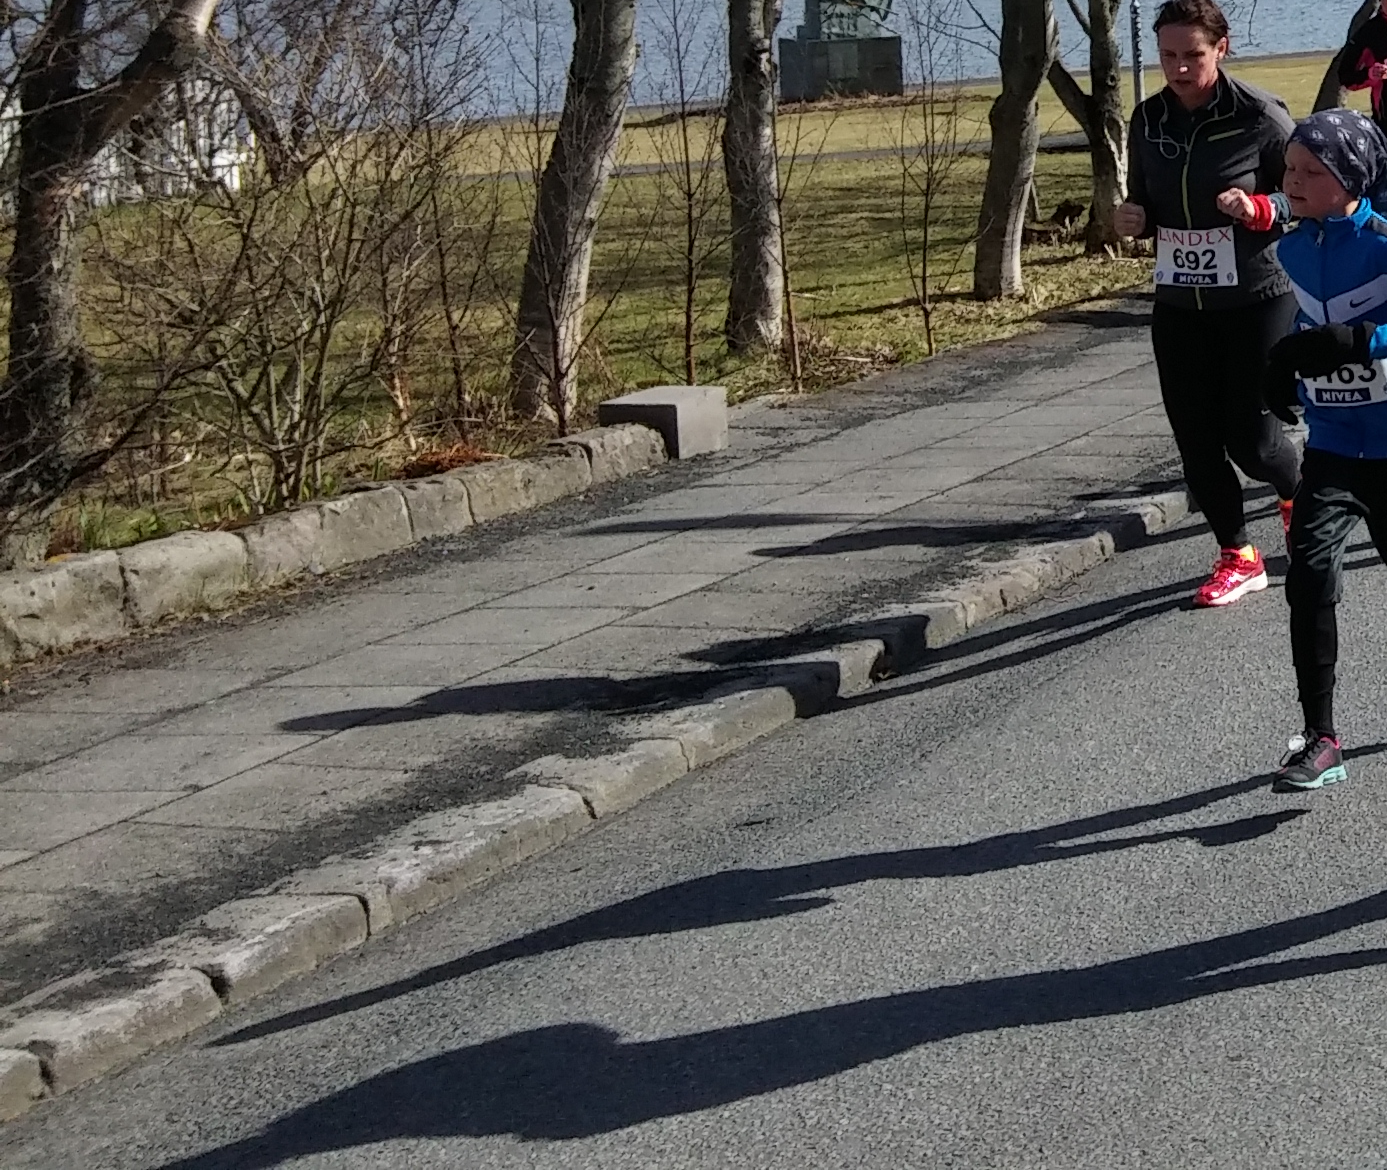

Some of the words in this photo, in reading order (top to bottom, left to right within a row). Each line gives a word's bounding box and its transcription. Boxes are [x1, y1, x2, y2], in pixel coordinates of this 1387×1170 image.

[1159, 228, 1231, 246] LINDEX
[1173, 248, 1217, 270] 692
[1179, 275, 1212, 283] NIVEA
[1322, 391, 1363, 401] NIVEA
